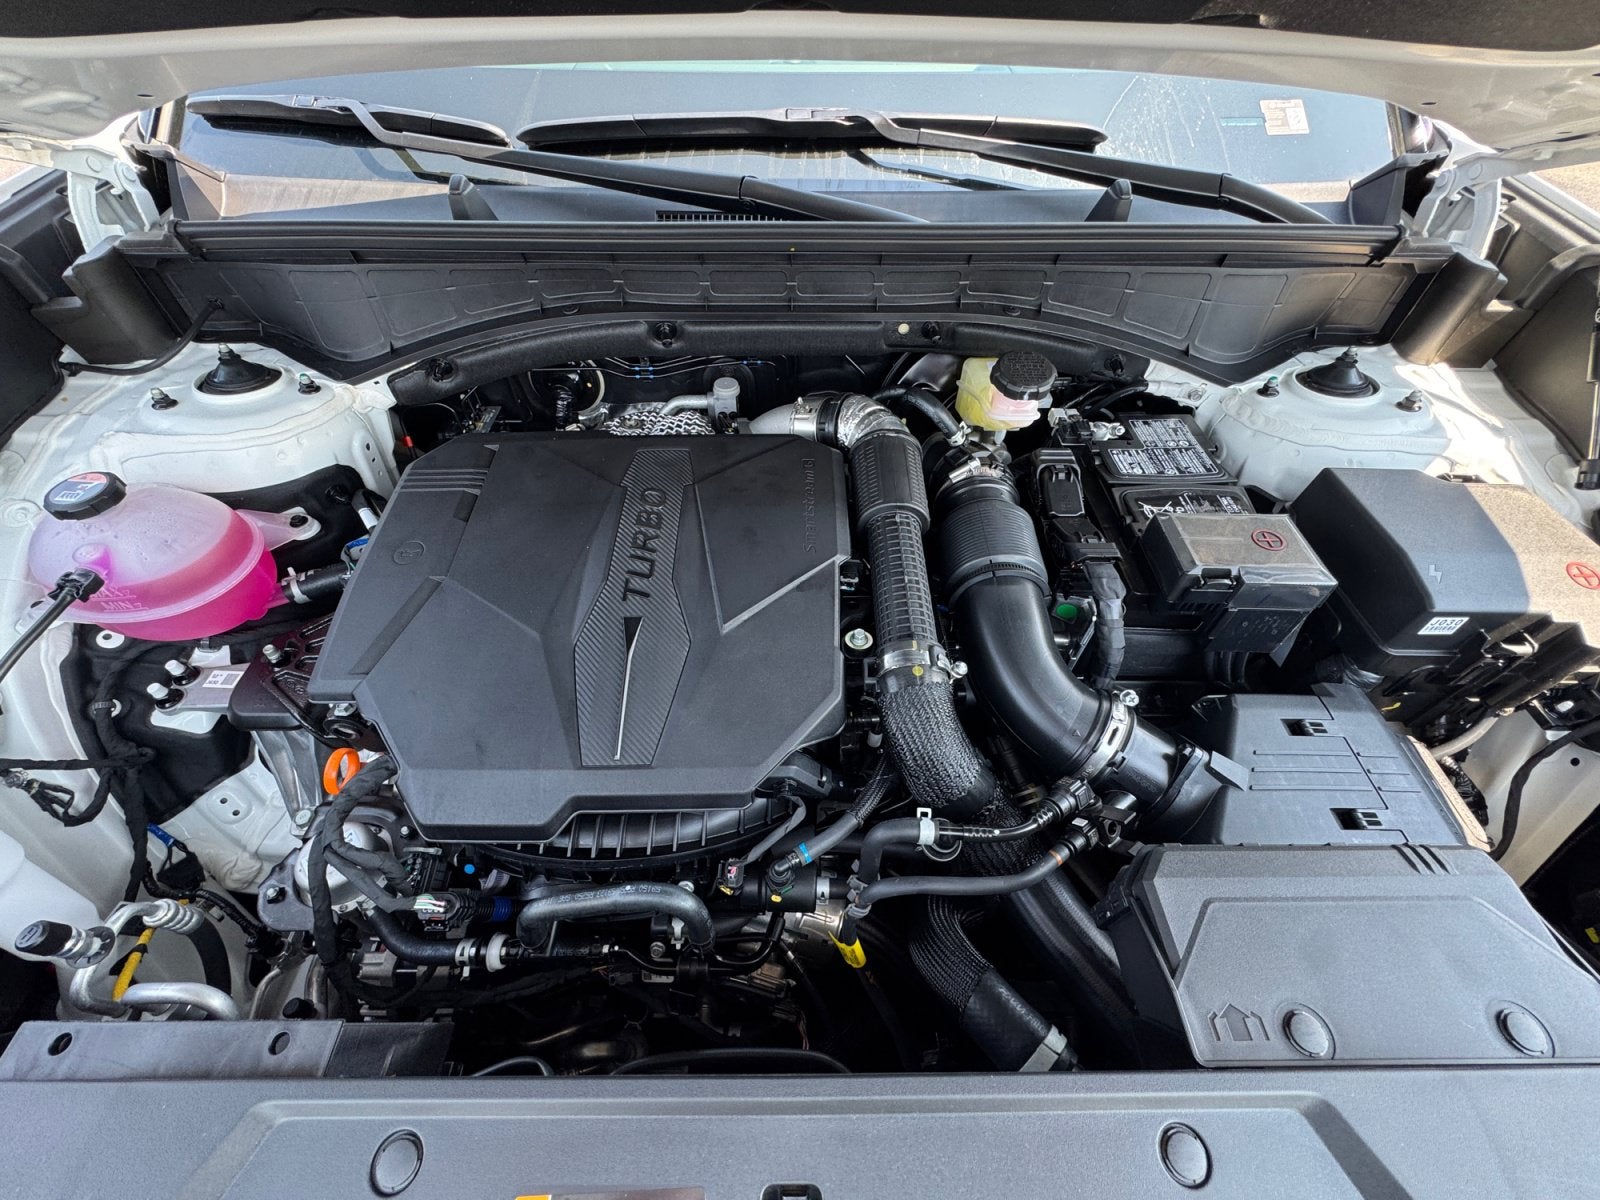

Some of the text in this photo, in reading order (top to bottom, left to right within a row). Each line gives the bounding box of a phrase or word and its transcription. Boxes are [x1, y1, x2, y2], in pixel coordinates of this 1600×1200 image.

[802, 469, 817, 554] Smartstream
[622, 488, 667, 601] TURBO
[100, 600, 135, 610] MIN
[1430, 618, 1465, 627] J030
